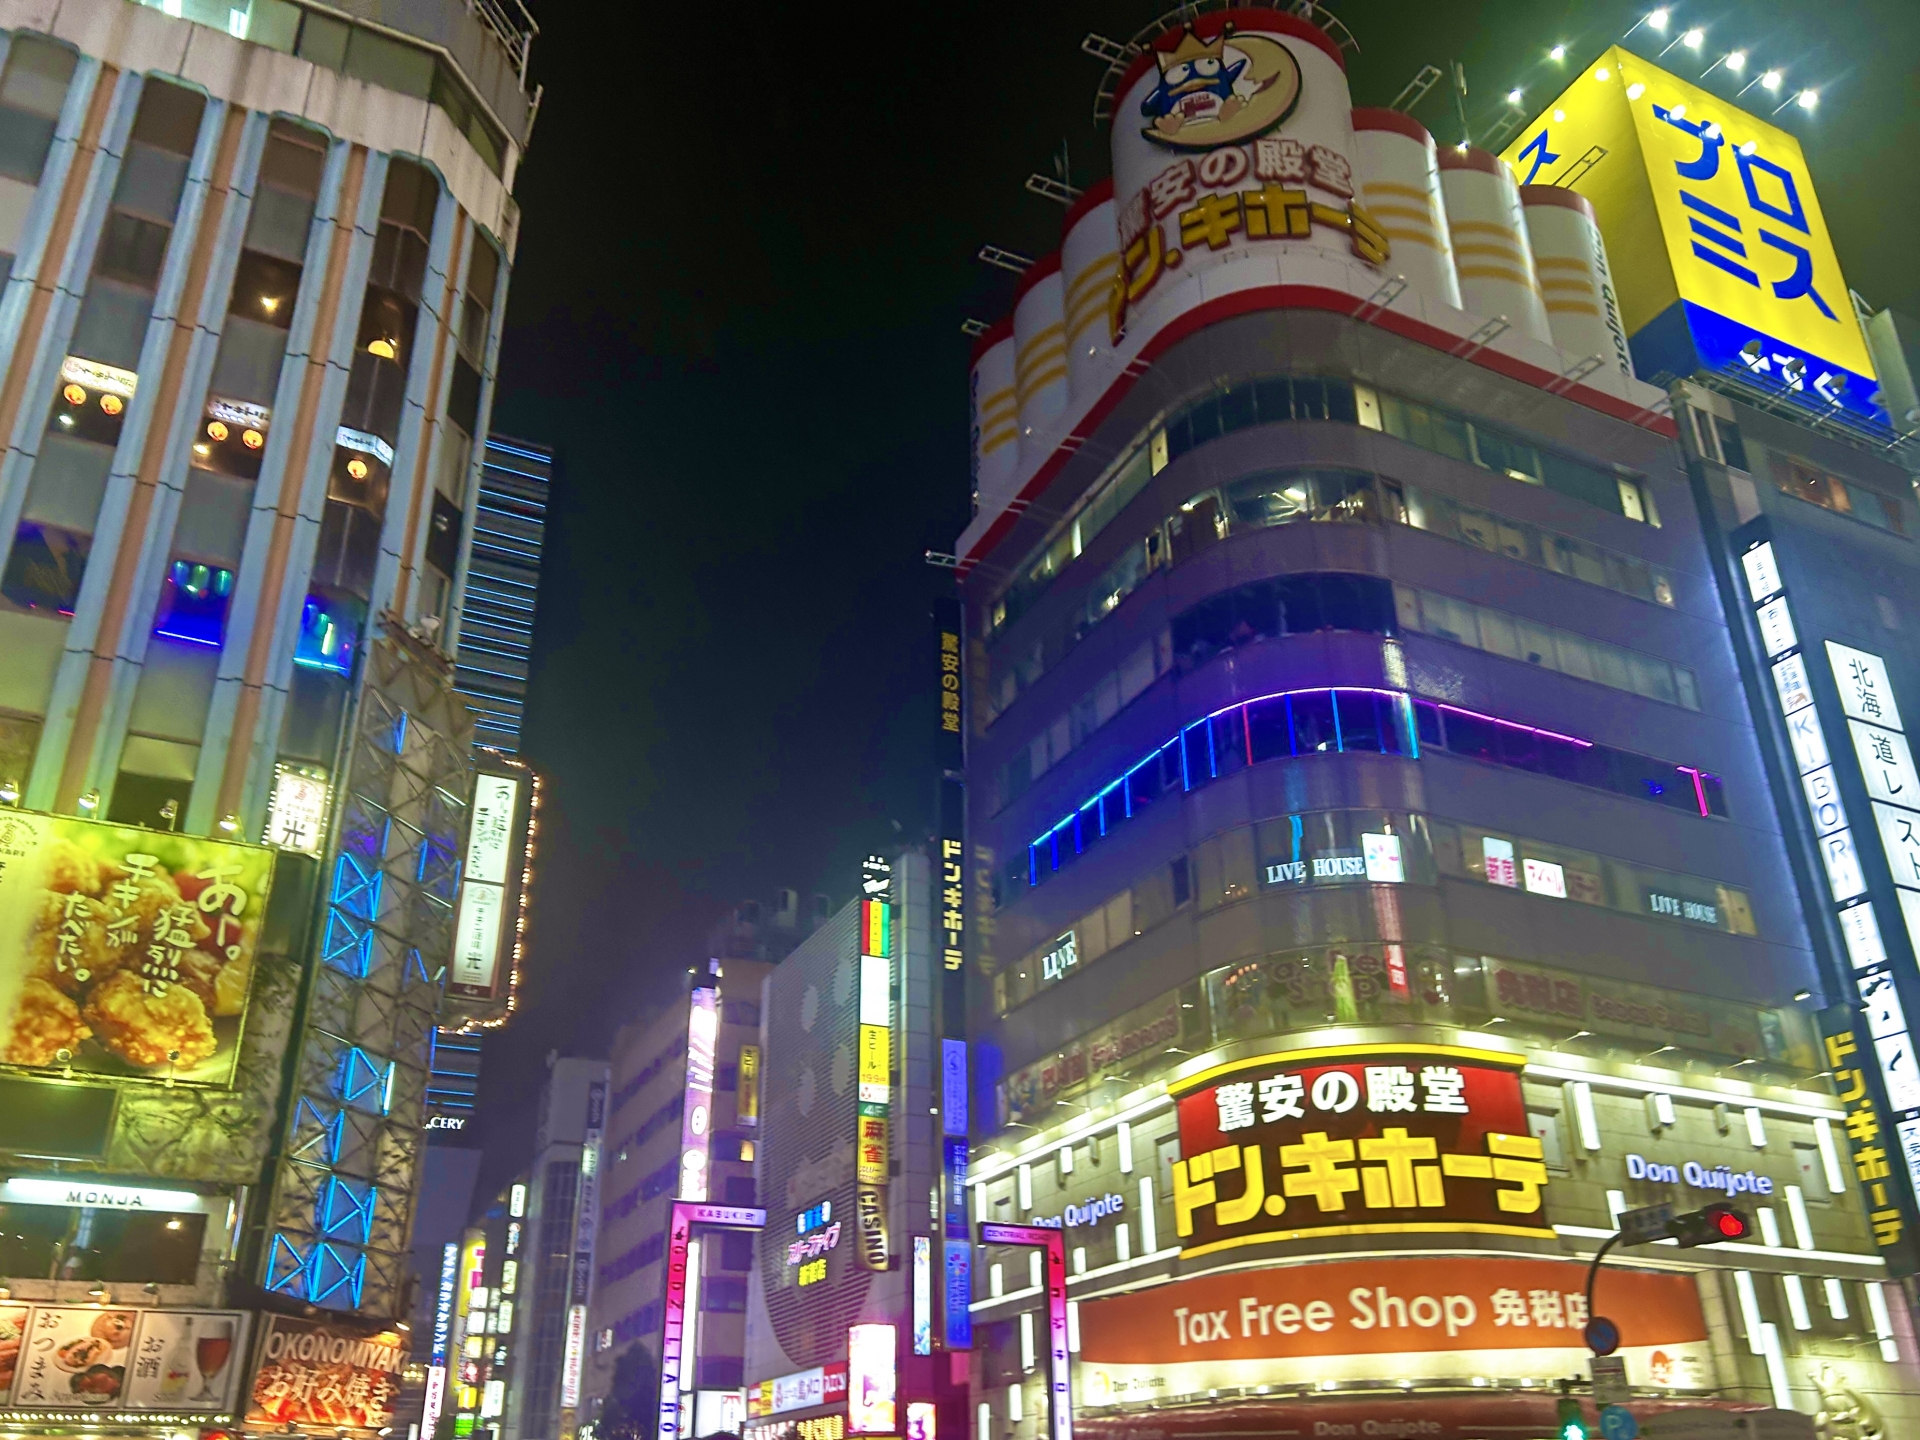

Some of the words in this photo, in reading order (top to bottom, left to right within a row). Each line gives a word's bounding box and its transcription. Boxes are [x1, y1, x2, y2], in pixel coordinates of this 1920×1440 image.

[1679, 189, 1843, 324] ミス
[1266, 860, 1307, 884] LIVE
[1312, 856, 1366, 877] HOUSE
[106, 854, 159, 947] チキンが
[1649, 893, 1682, 917] LIVE
[142, 904, 196, 998] 猛烈に
[1215, 1066, 1470, 1132] 驚安の殿堂
[862, 1121, 885, 1164] 麻雀
[1626, 1154, 1680, 1184] Don
[1683, 1161, 1773, 1198] Quijote
[65, 1190, 144, 1207] MONJA
[1064, 1193, 1123, 1227] Quijote
[860, 1190, 885, 1265] CASINO
[1174, 1307, 1232, 1346] Tax
[1239, 1297, 1336, 1338] Free
[1349, 1286, 1478, 1338] Shop
[1490, 1287, 1592, 1330] 免税店
[21, 1311, 63, 1401] おつまみ
[136, 1335, 166, 1379] お酒
[262, 1366, 393, 1411] お好み焼き
[1314, 1421, 1357, 1437] Don
[1361, 1418, 1442, 1438] Quijote
